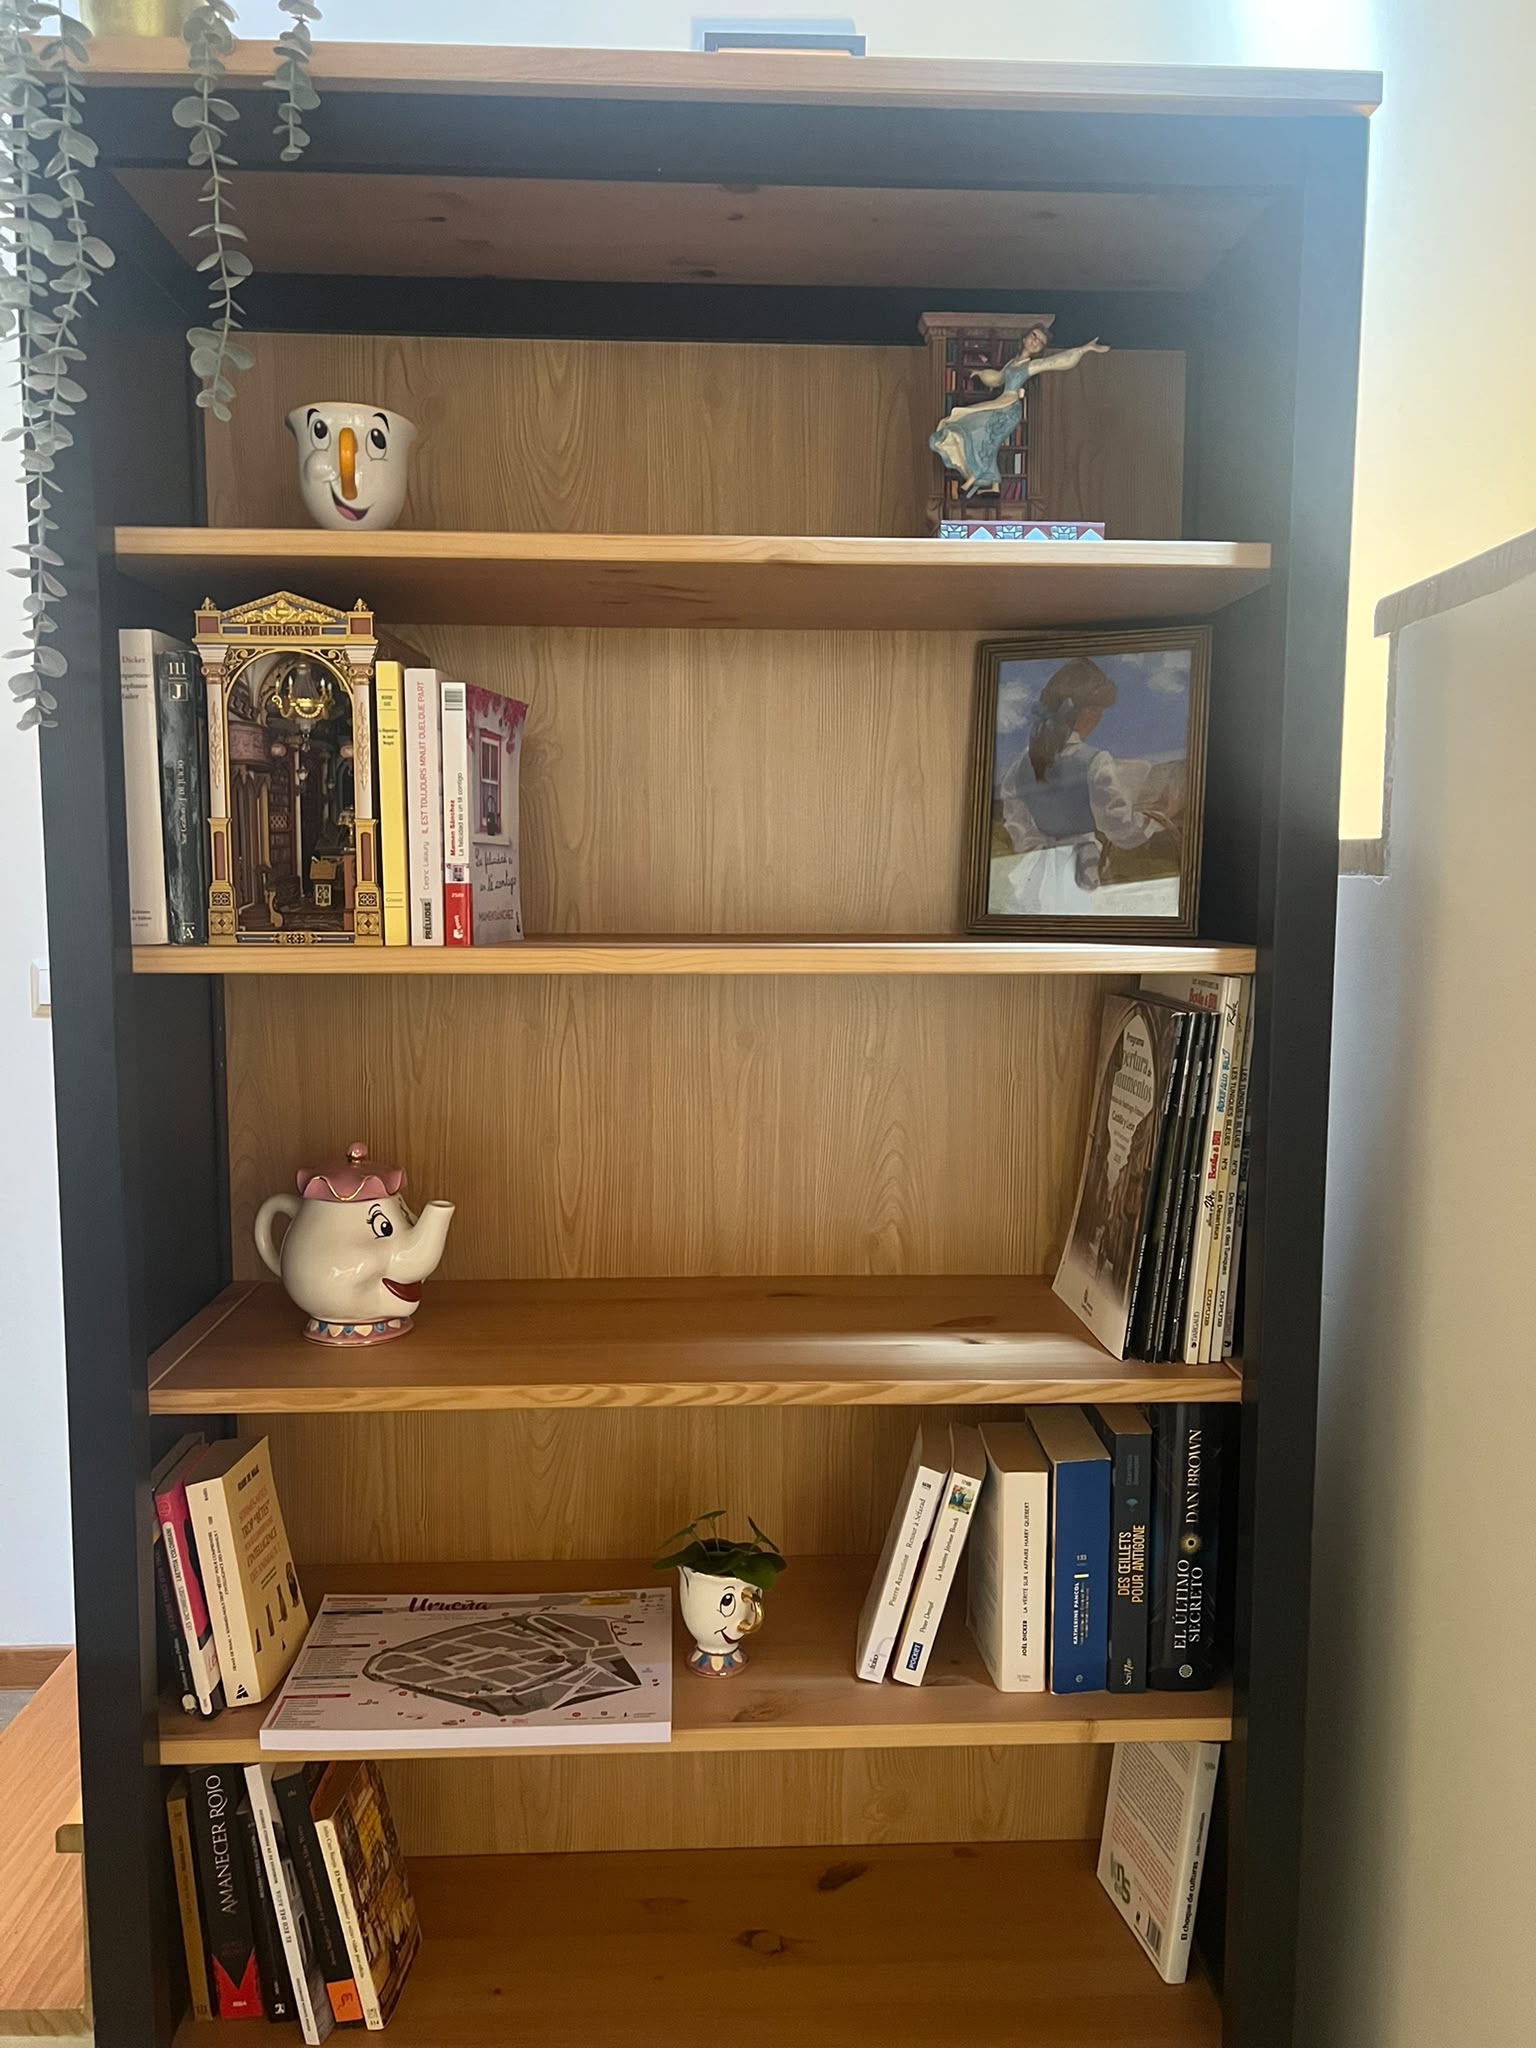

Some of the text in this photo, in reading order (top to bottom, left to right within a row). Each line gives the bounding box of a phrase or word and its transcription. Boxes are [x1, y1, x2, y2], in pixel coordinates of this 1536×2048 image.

[172, 683, 182, 700] J
[415, 680, 425, 702] PART
[416, 704, 426, 739] QUELQUE
[417, 741, 426, 766] MINUIT
[418, 767, 428, 808] TOUJOURS
[456, 771, 464, 796] contigo
[419, 810, 428, 825] EST
[458, 803, 463, 812] un
[448, 830, 456, 856] Mamen
[458, 848, 464, 857] La
[422, 901, 432, 939] PRÉLUDES
[1240, 1067, 1249, 1082] LES
[1222, 1066, 1239, 1146] LES TUNIQUES BLEUES
[1235, 1083, 1247, 1119] TUNIQUES
[1211, 1129, 1222, 1146] Bill
[1232, 1119, 1243, 1149] BLEUES
[1206, 1152, 1219, 1180] Boule
[1227, 1191, 1235, 1206] Des
[1224, 1233, 1232, 1246] des
[1220, 1246, 1230, 1275] Tuniques
[1184, 1429, 1203, 1523] DAN BROWN
[887, 1585, 899, 1606] Pierre
[894, 1553, 909, 1586] Assouline
[904, 1525, 917, 1548] Retour
[1117, 1530, 1131, 1596] DES ŒILLETS
[1129, 1523, 1147, 1603] POUR ANTIGONE
[408, 1596, 489, 1613] Urueña
[1072, 1581, 1080, 1608] PANCOL
[1171, 1558, 1192, 1649] EL ÚLTIMO
[1183, 1565, 1207, 1643] SECRETO
[1021, 1606, 1027, 1614] LA
[908, 1643, 922, 1669] POCKET
[204, 1773, 229, 1818] ROJO
[210, 1820, 239, 1914] AMANECER
[1180, 1860, 1199, 1941] El choque de culturas
[274, 1889, 292, 1944] EL ECO DEL AGUA
